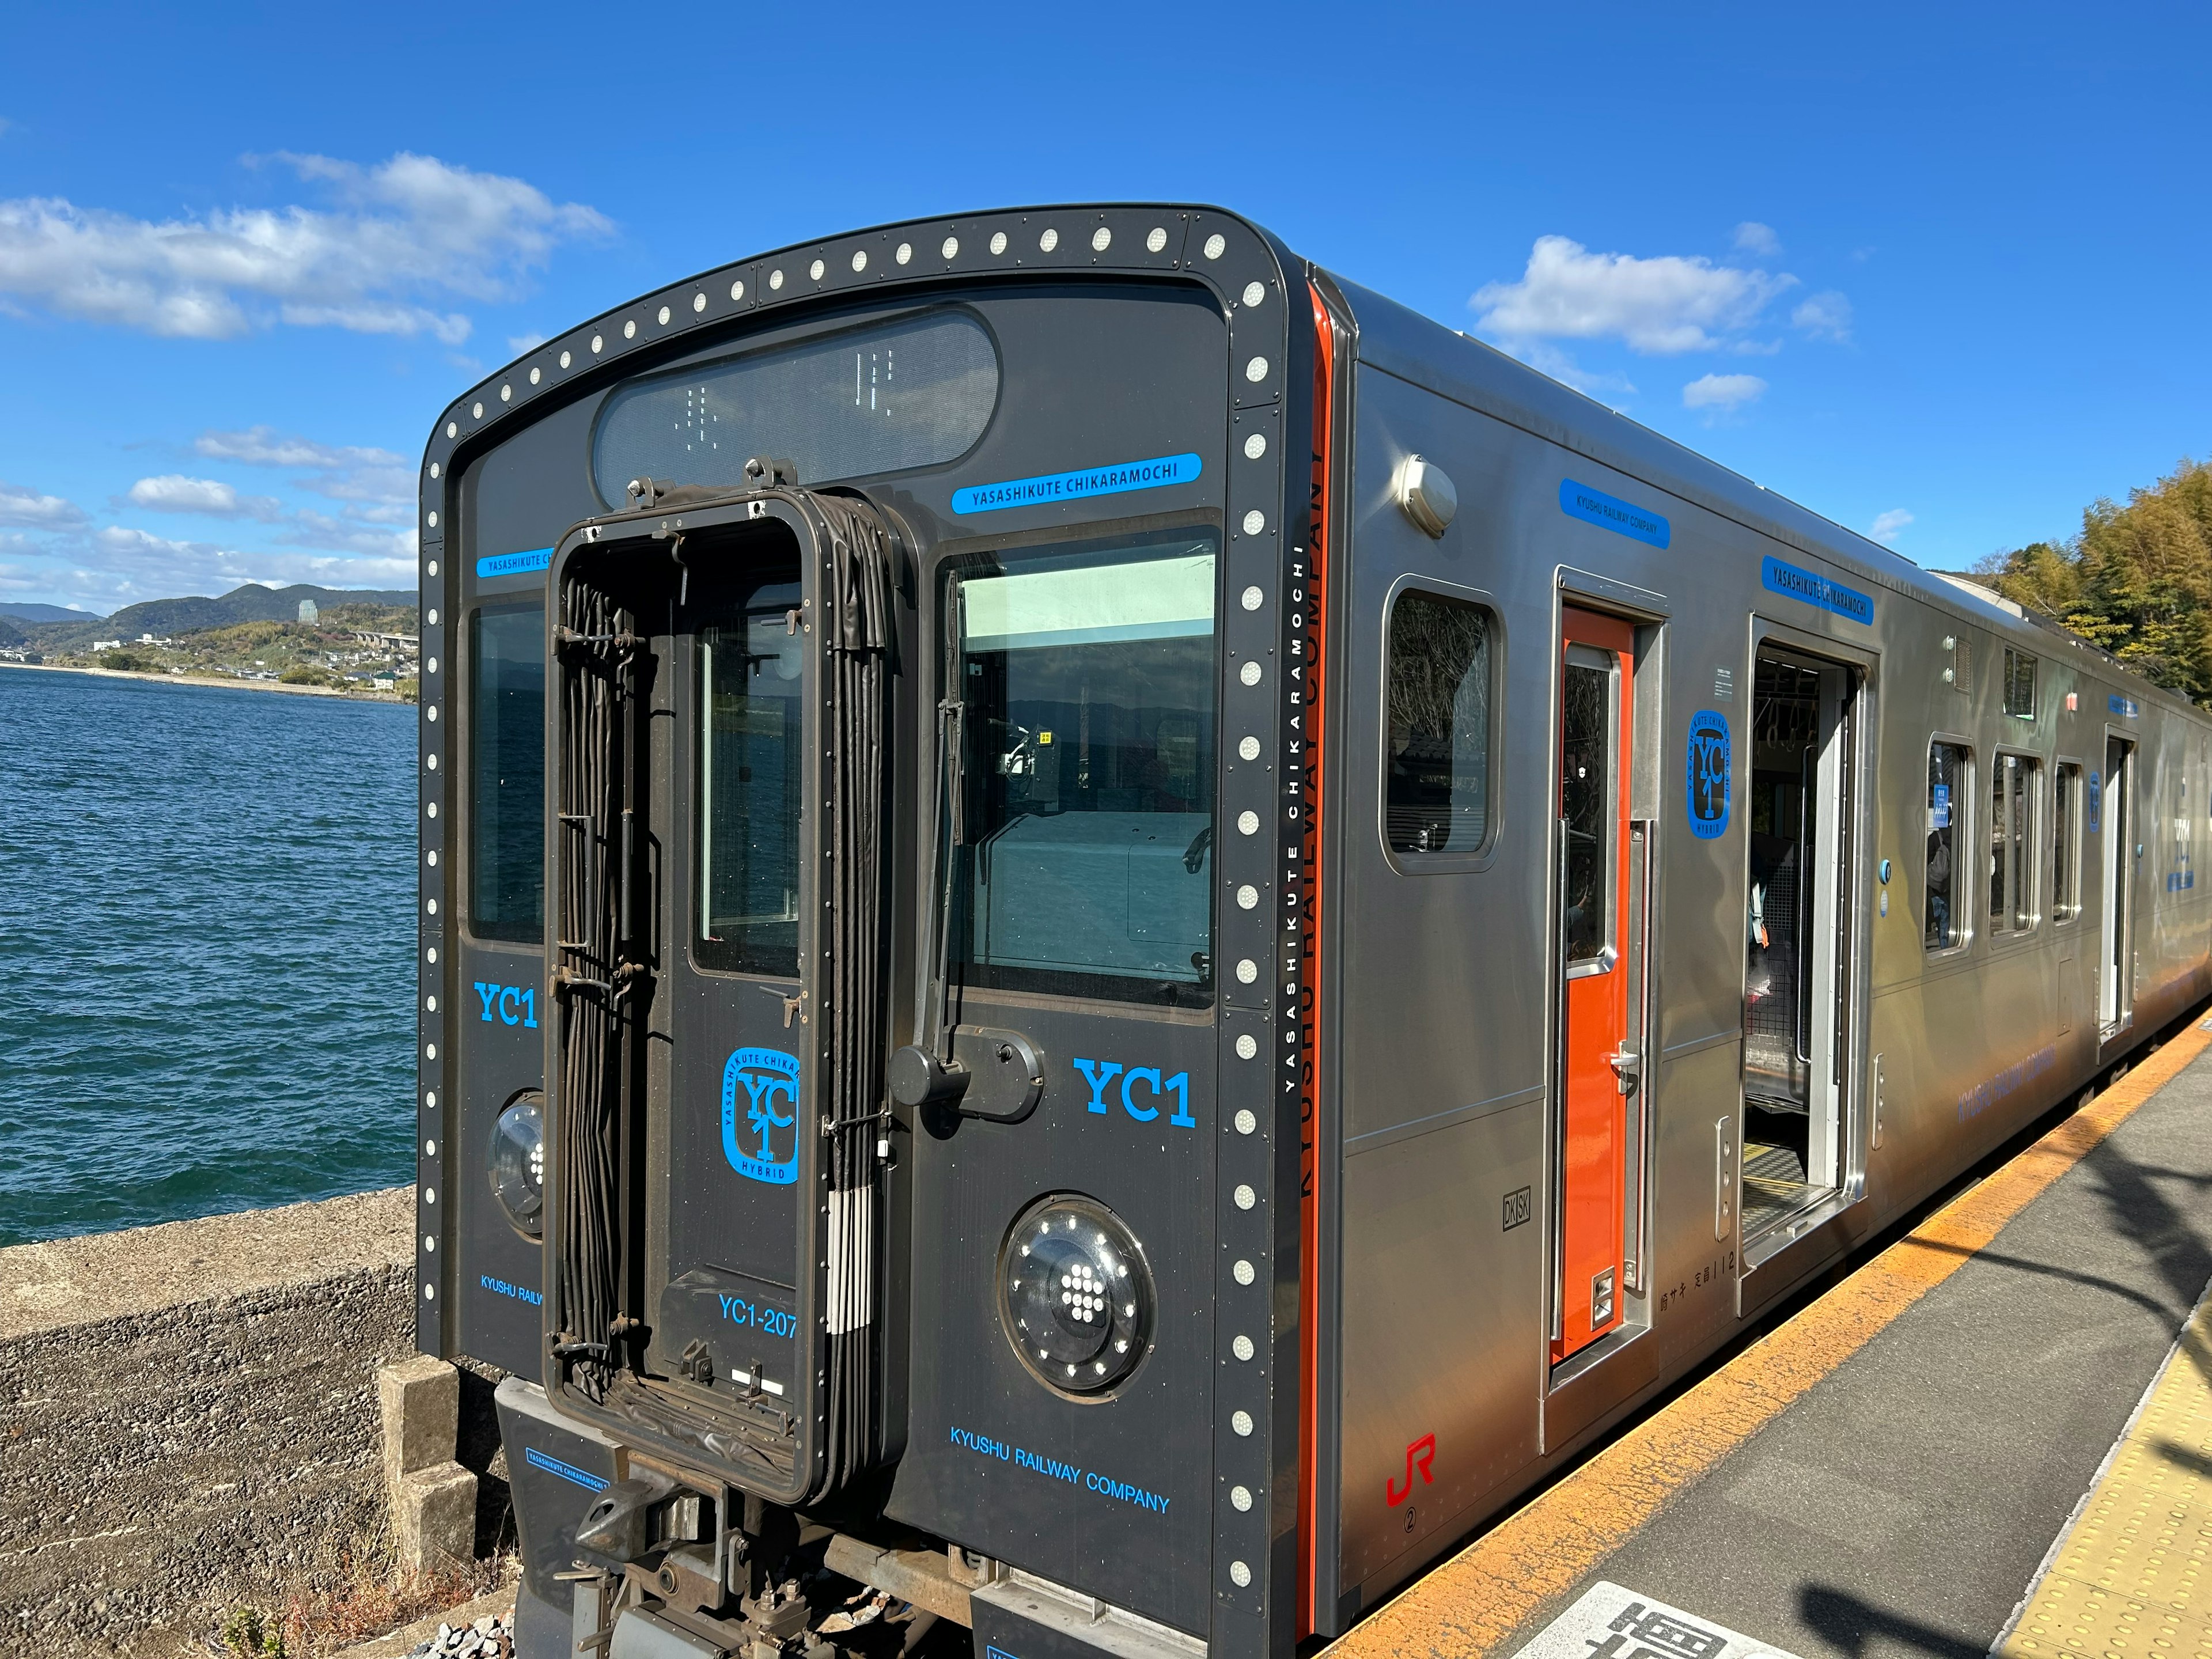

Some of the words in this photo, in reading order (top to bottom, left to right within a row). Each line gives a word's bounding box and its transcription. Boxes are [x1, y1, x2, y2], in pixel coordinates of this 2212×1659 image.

[972, 480, 1060, 506] YASASHIKUTE
[1066, 463, 1177, 492] CHIKARAMOCHI
[1577, 494, 1602, 514] KYUSHU
[1604, 505, 1629, 524] RAILWAY
[1630, 516, 1657, 535] COMPANY
[488, 555, 540, 571] YASASHIKUTE
[1773, 566, 1820, 599] YASASHIKUTE
[1823, 585, 1866, 616] CHIKARAMOCHI
[1288, 546, 1304, 819] CHIKARAMOCHI
[1697, 824, 1719, 834] HYBRID
[1285, 846, 1298, 1092] YASASHIKUTE
[474, 981, 538, 1028] YC1
[725, 1054, 759, 1125] YASASHIKUTE
[1073, 1058, 1195, 1128] YC1
[742, 1161, 785, 1179] HYBRID
[1505, 1198, 1516, 1225] DK
[1518, 1192, 1528, 1219] SK
[481, 1274, 516, 1297] KYUSHU
[718, 1293, 796, 1339] YC1-207
[529, 1453, 563, 1472] YASASHIKUTE
[564, 1467, 603, 1490] CHIKARAMOCHI
[950, 1426, 1010, 1461] KYUSHU
[1015, 1448, 1081, 1484] RAILWAY
[1086, 1472, 1170, 1514] COMPANY
[1387, 1431, 1435, 1508] JR
